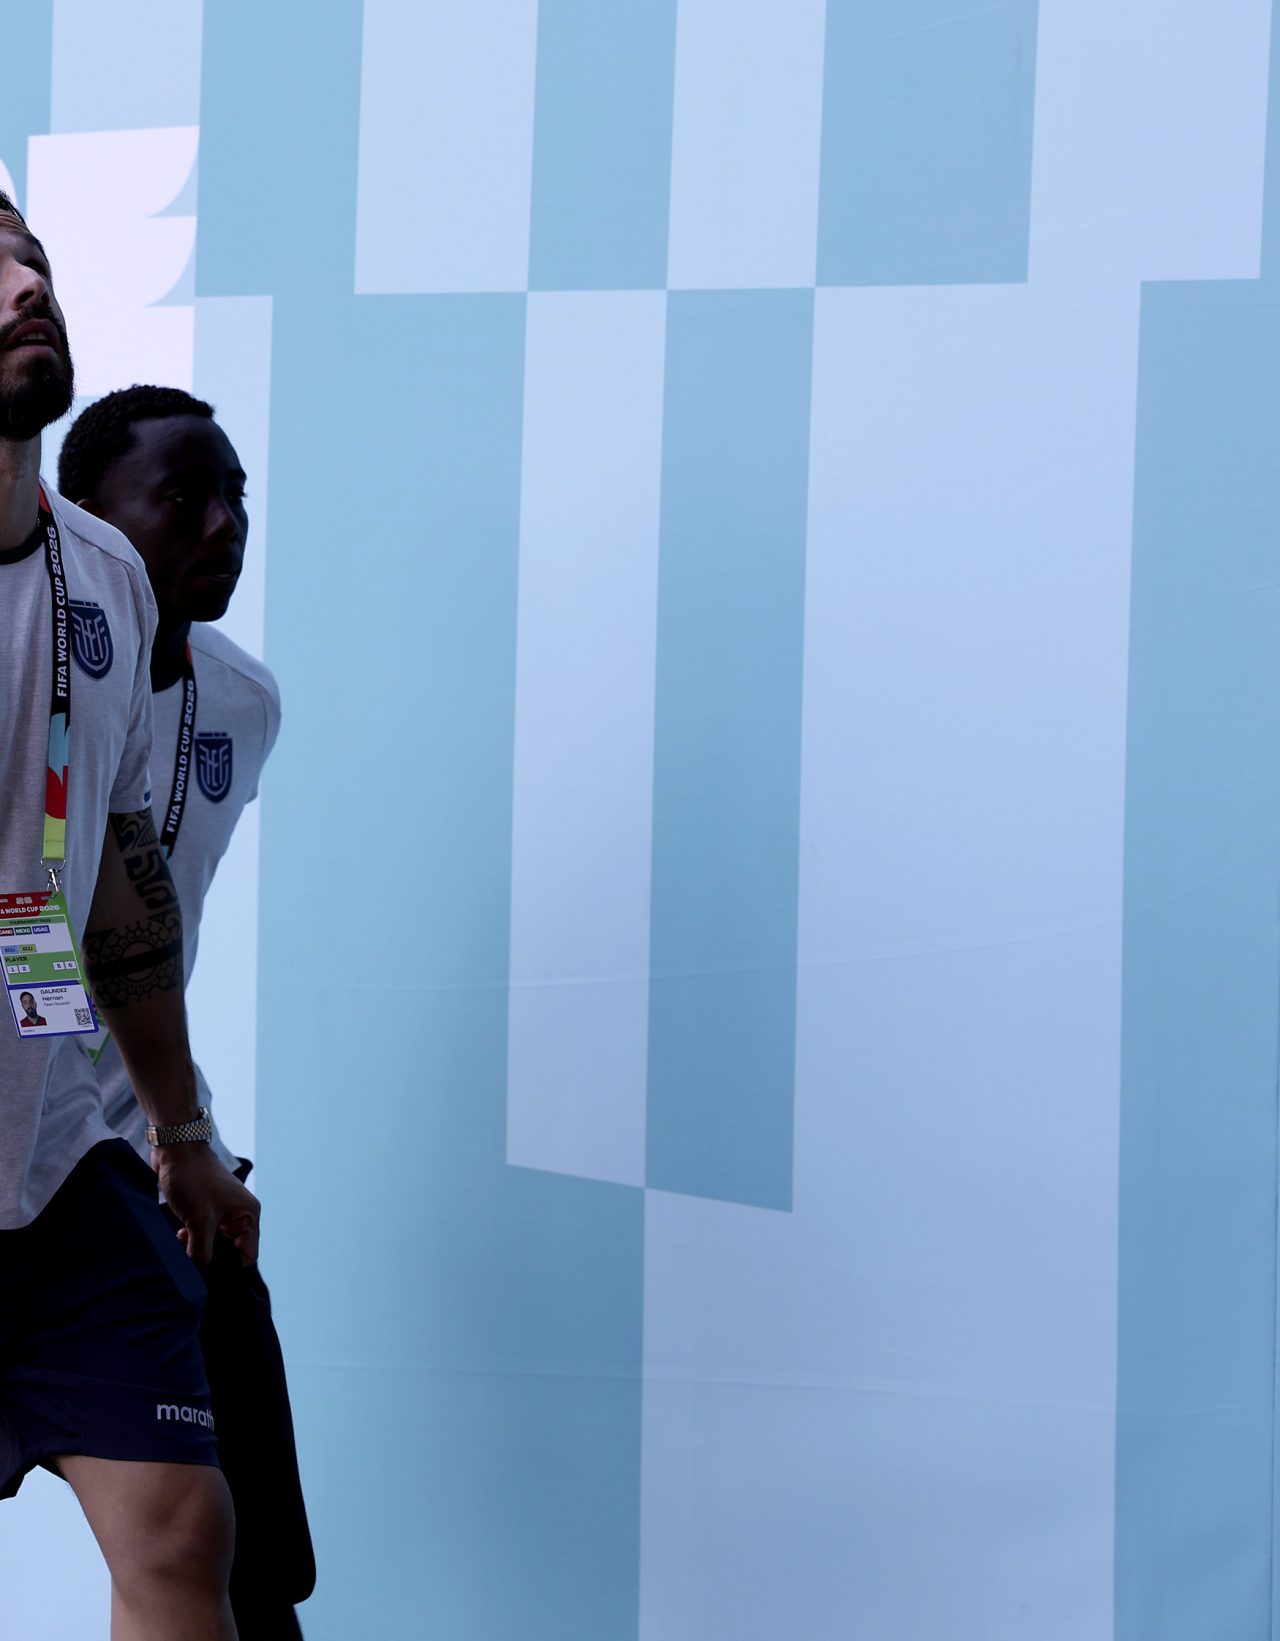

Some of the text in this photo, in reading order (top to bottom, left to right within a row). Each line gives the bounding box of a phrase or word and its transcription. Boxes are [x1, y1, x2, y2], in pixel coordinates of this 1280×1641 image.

[47, 526, 68, 697] FIFA WORLD CUP 2026
[166, 805, 180, 832] FIFA
[174, 755, 188, 803] WORLD
[182, 727, 190, 753] CUP
